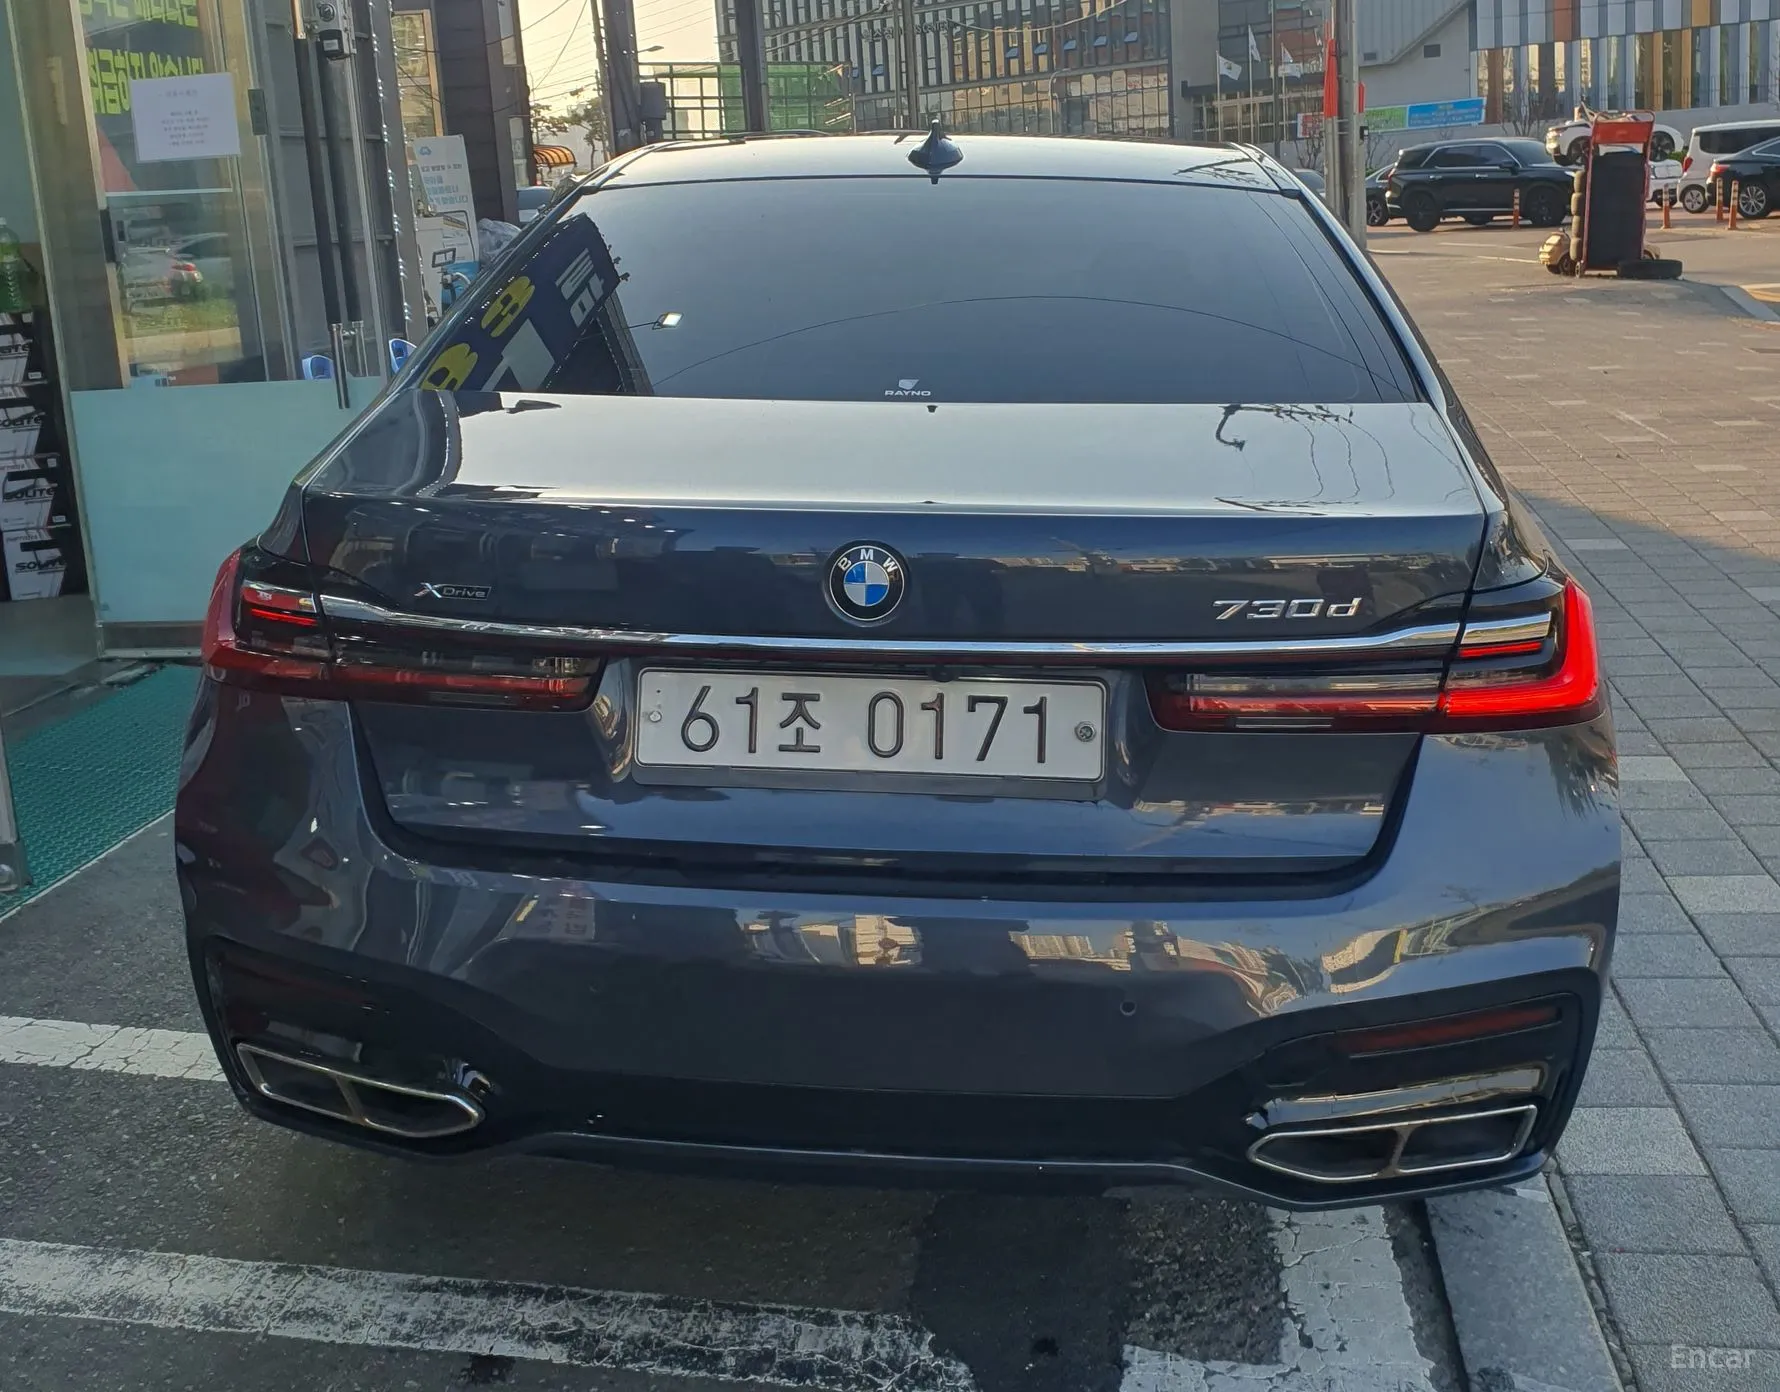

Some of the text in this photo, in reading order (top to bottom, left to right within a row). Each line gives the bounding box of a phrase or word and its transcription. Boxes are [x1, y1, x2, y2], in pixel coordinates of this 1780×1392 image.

[838, 548, 898, 572] BMW
[1213, 597, 1362, 620] 730d
[680, 685, 1048, 764] 61조 0171
